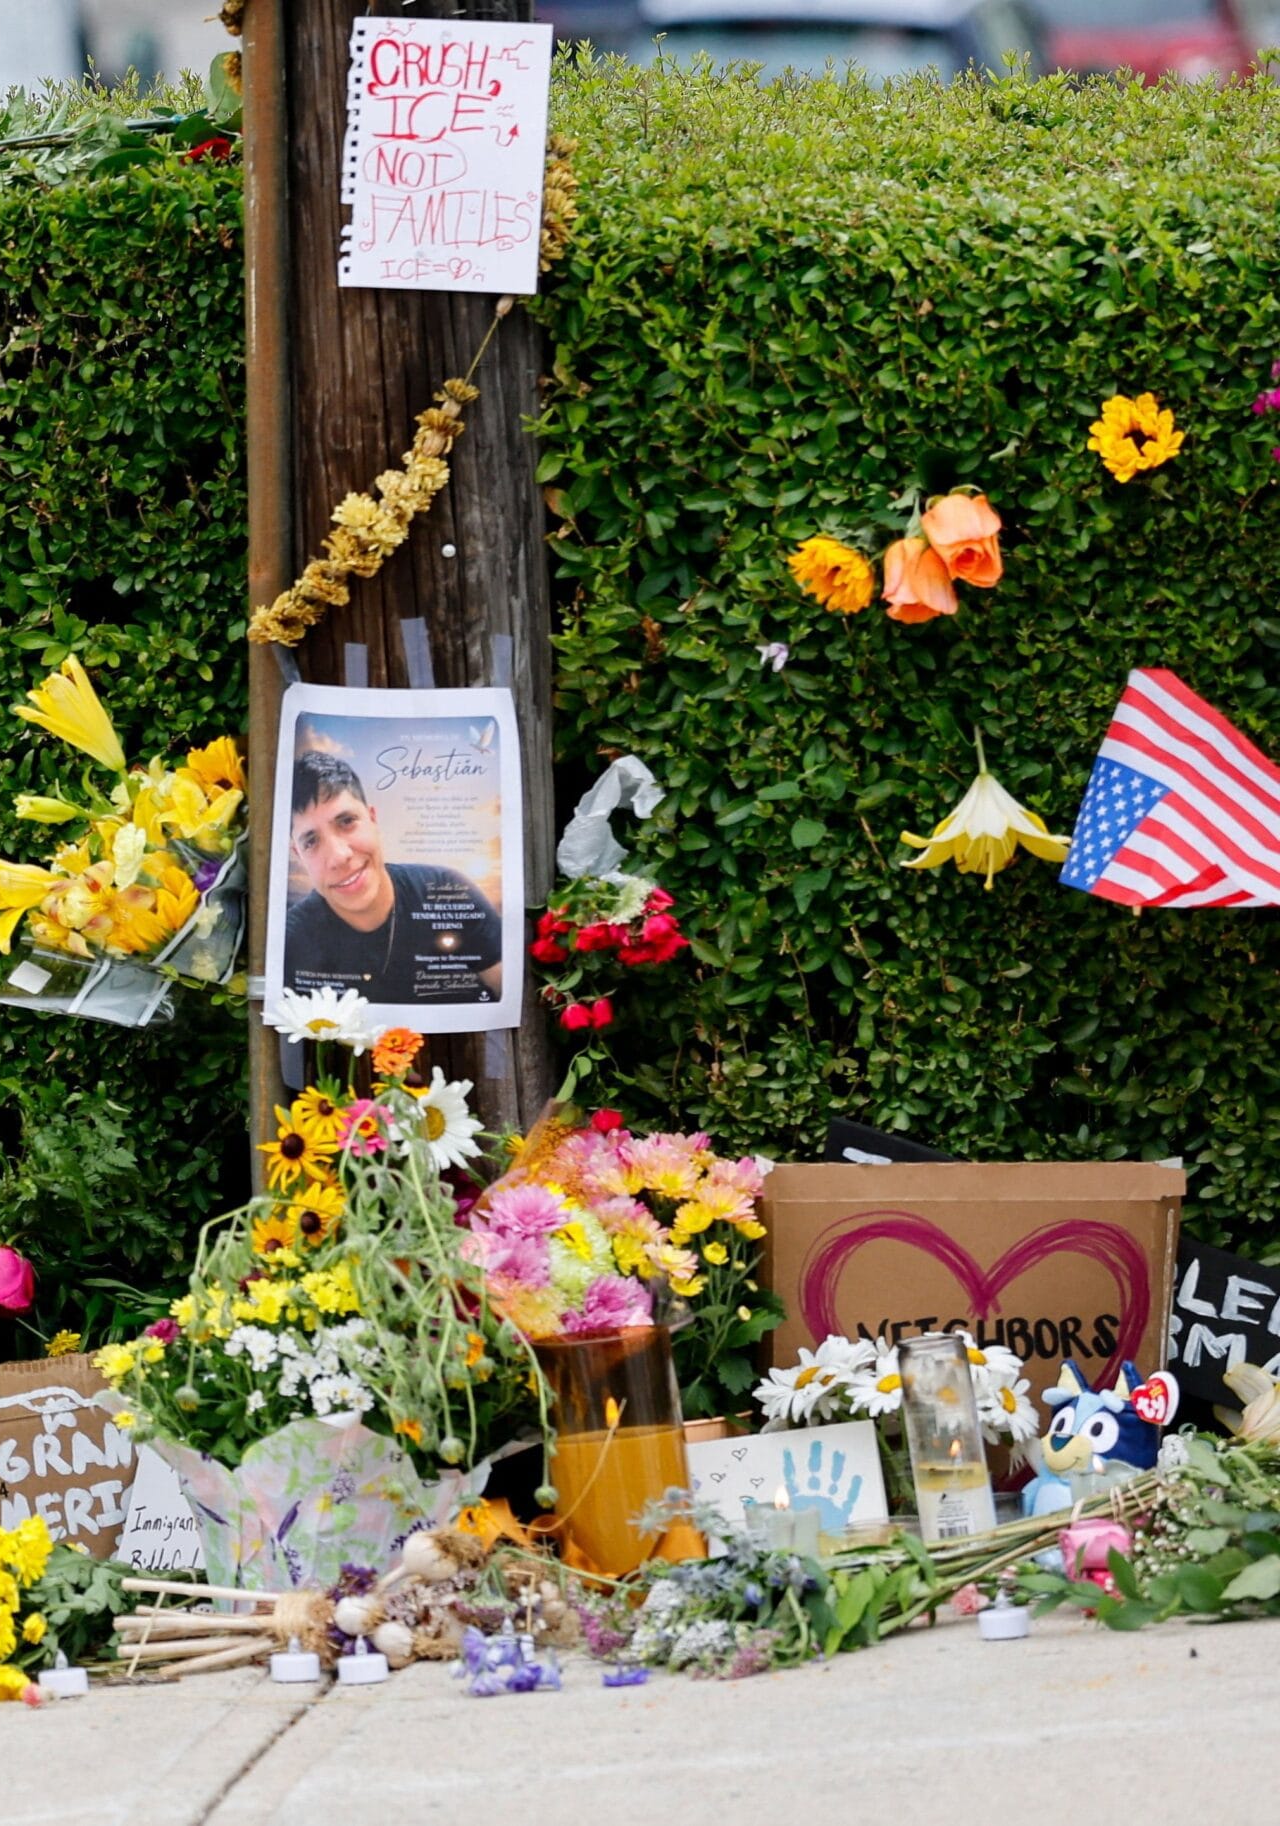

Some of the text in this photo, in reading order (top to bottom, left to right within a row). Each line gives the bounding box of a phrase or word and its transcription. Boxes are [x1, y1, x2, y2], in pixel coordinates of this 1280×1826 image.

[373, 91, 493, 143] ICE
[376, 147, 453, 187] NOT
[376, 746, 487, 791] Sebastián
[130, 1506, 198, 1541] Immigran
